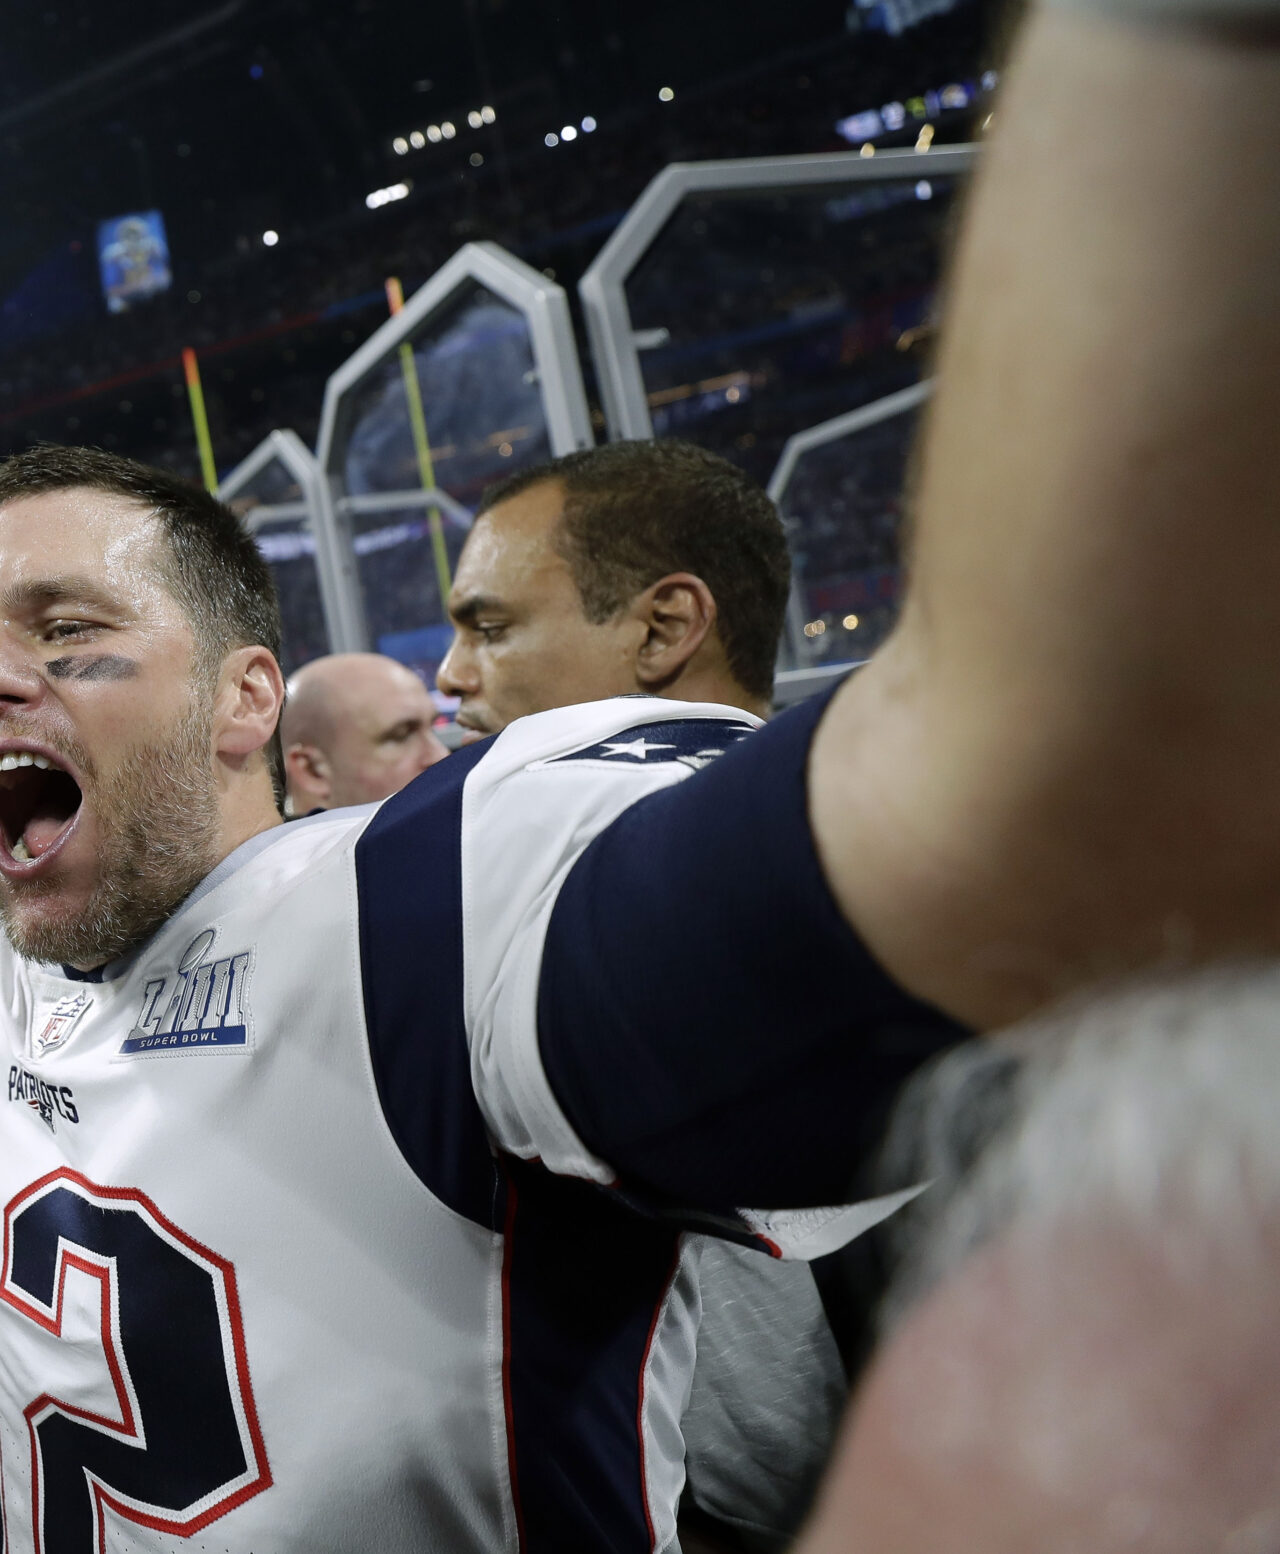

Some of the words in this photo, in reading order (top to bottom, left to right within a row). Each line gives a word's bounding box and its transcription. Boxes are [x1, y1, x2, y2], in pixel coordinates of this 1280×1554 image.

[139, 1036, 178, 1048] SUPER
[181, 1032, 218, 1044] BOWL
[8, 1065, 80, 1124] PATRIOTS
